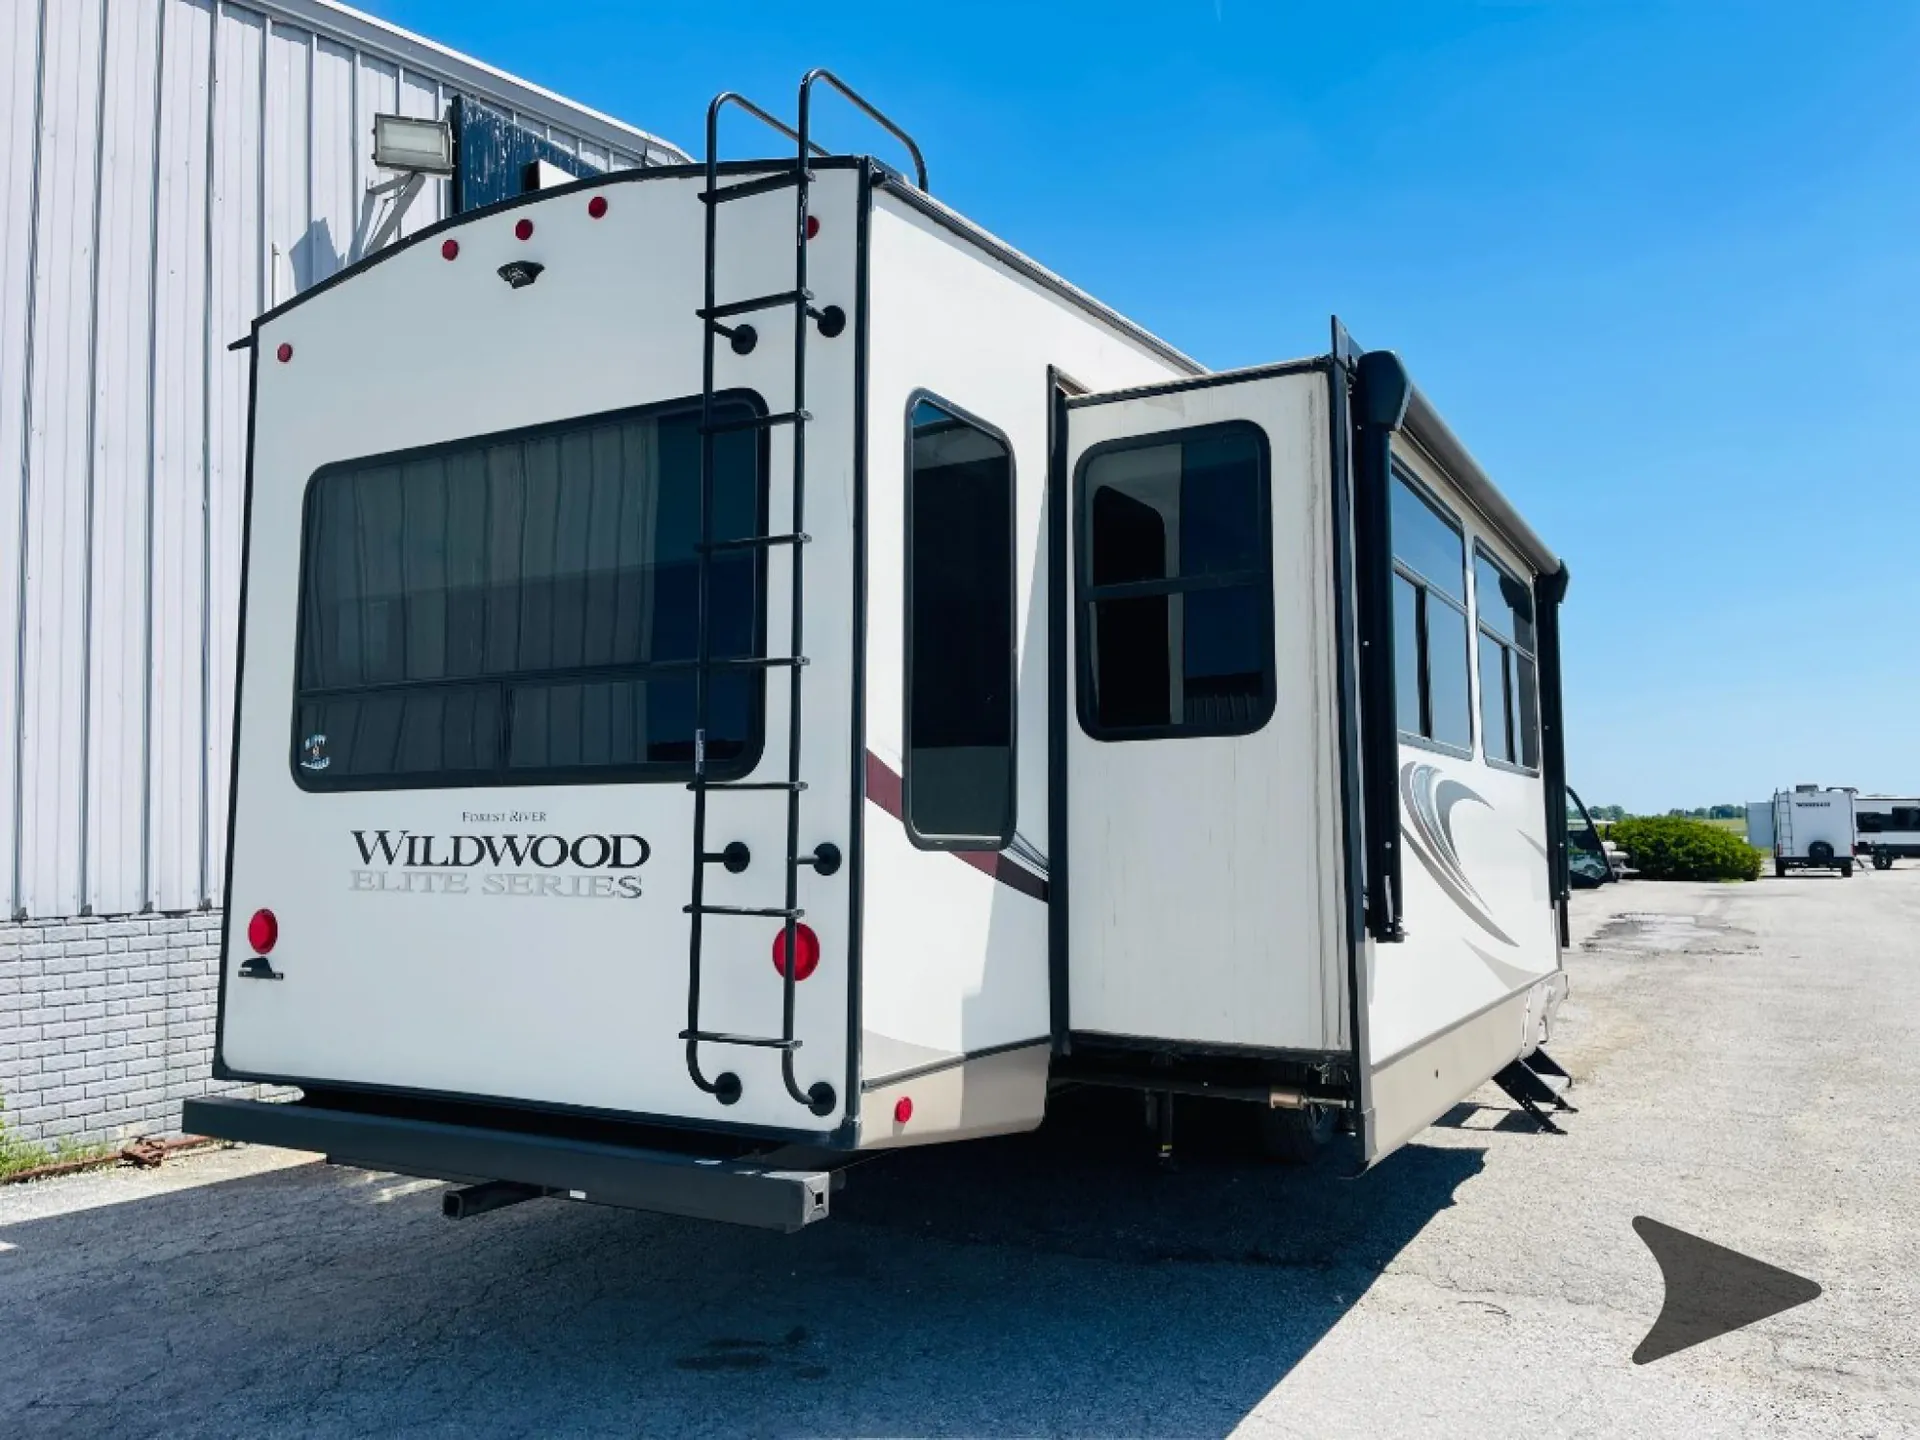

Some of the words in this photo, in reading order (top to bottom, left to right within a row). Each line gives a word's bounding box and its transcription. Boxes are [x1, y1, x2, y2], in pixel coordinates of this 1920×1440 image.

[509, 811, 547, 822] RIVER
[350, 830, 651, 869] WILDWOOD
[349, 870, 469, 894] ELITE
[482, 873, 642, 899] SERIES
